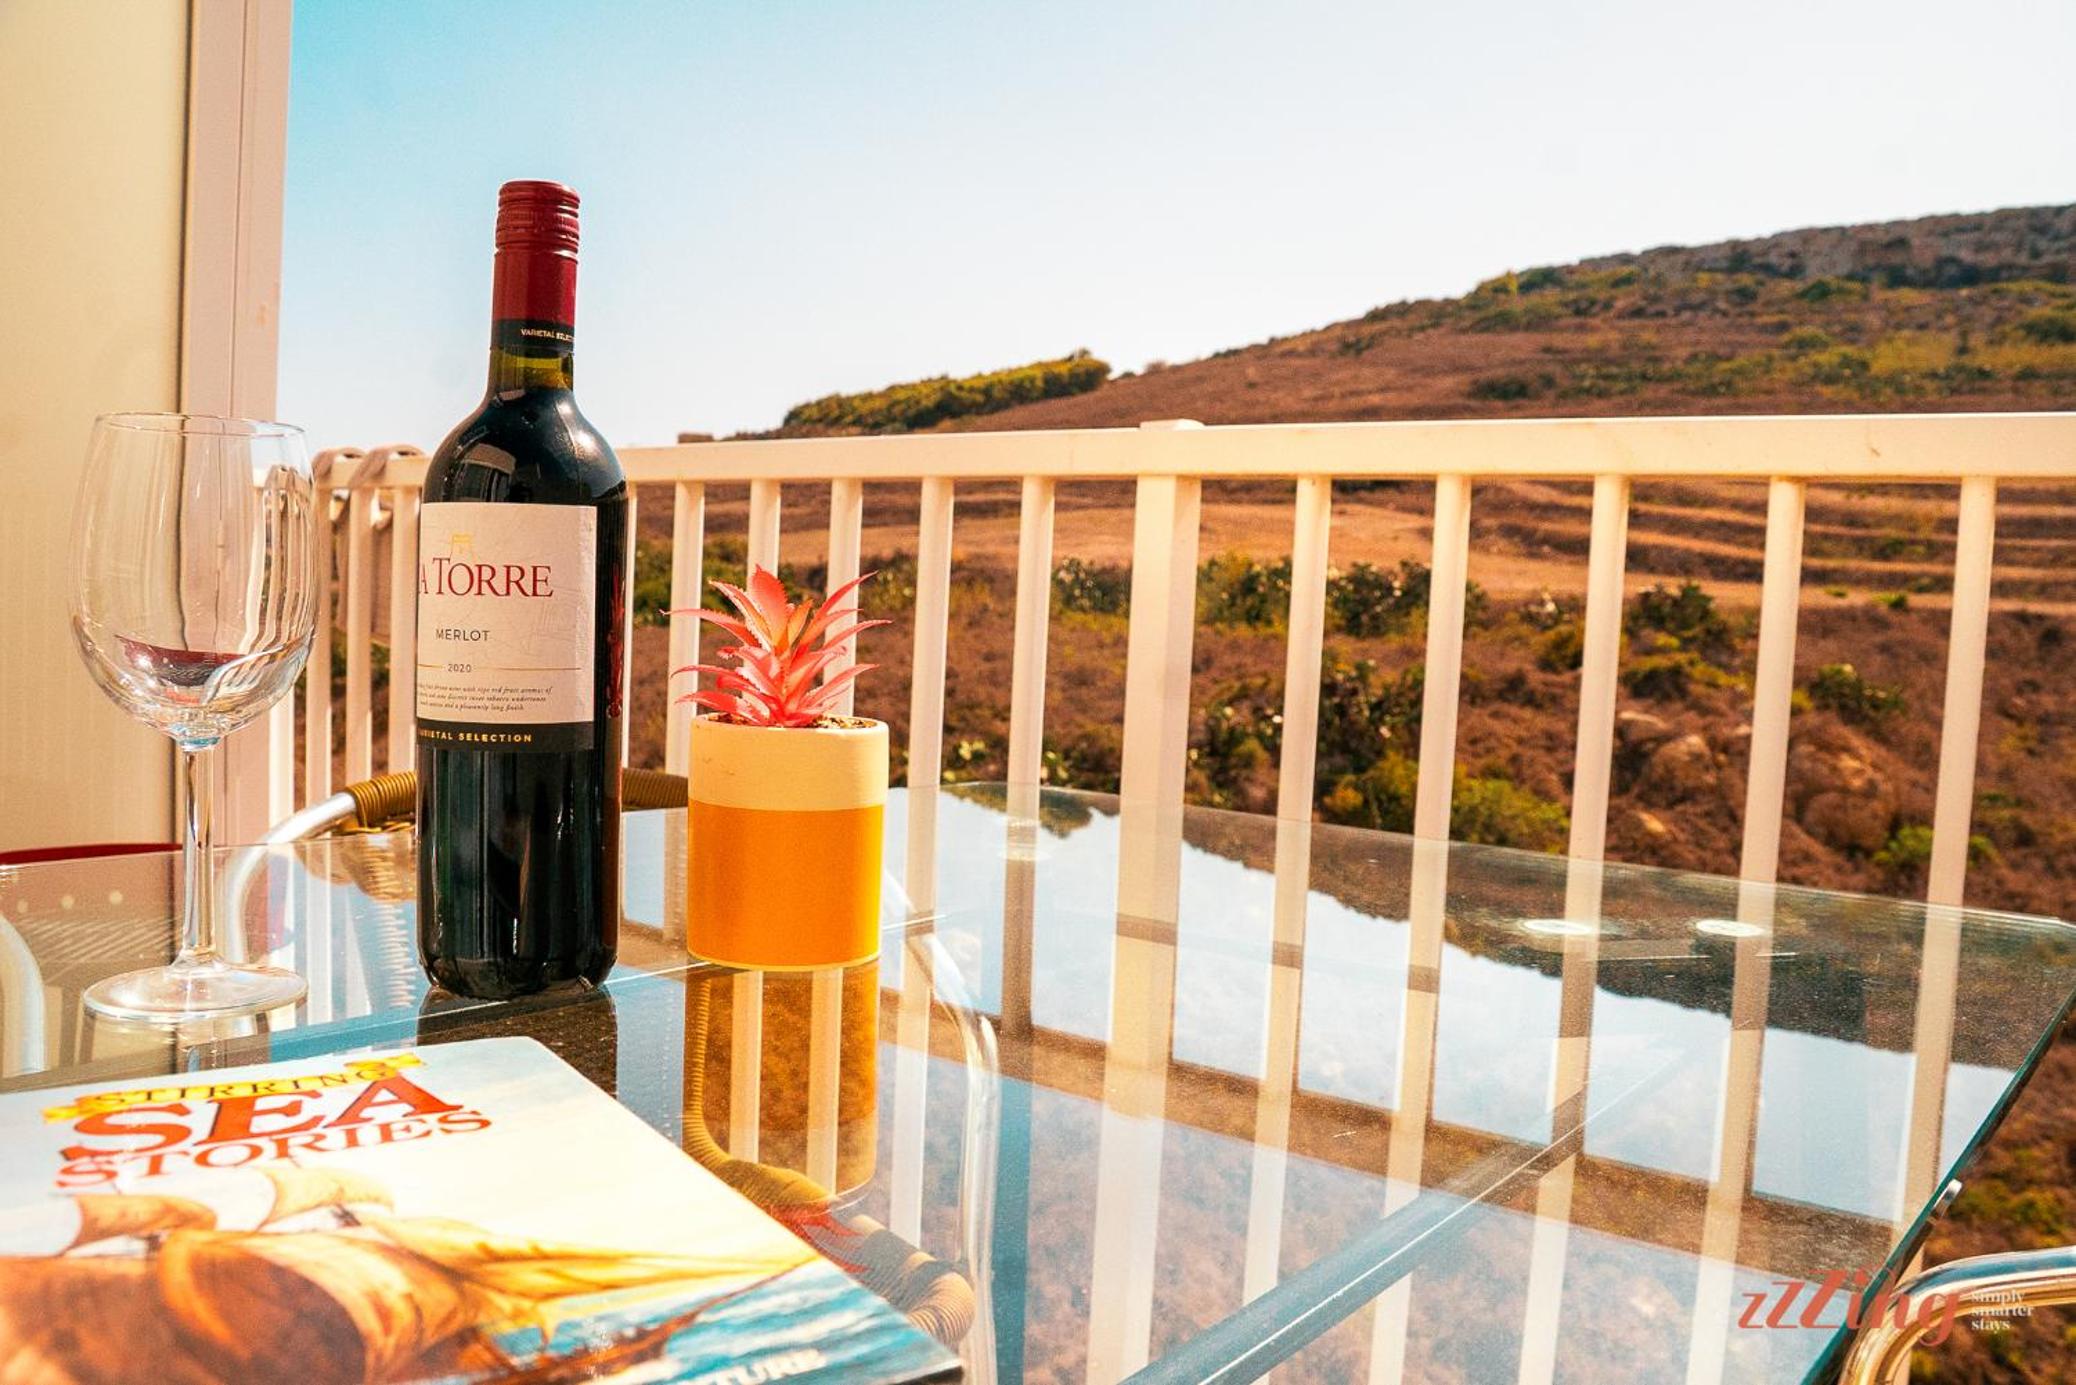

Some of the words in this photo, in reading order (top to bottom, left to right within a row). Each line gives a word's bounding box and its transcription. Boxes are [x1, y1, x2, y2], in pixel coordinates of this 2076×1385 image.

[521, 328, 555, 338] VARIETAL
[432, 557, 554, 597] TORRE
[435, 629, 491, 642] MERLOT
[447, 663, 472, 673] 2020
[491, 685, 501, 693] red
[544, 685, 553, 695] of
[458, 732, 532, 743] SELECTION
[93, 1067, 392, 1106] STIRRING
[60, 1074, 465, 1162] SEA
[54, 1109, 494, 1189] STORIES
